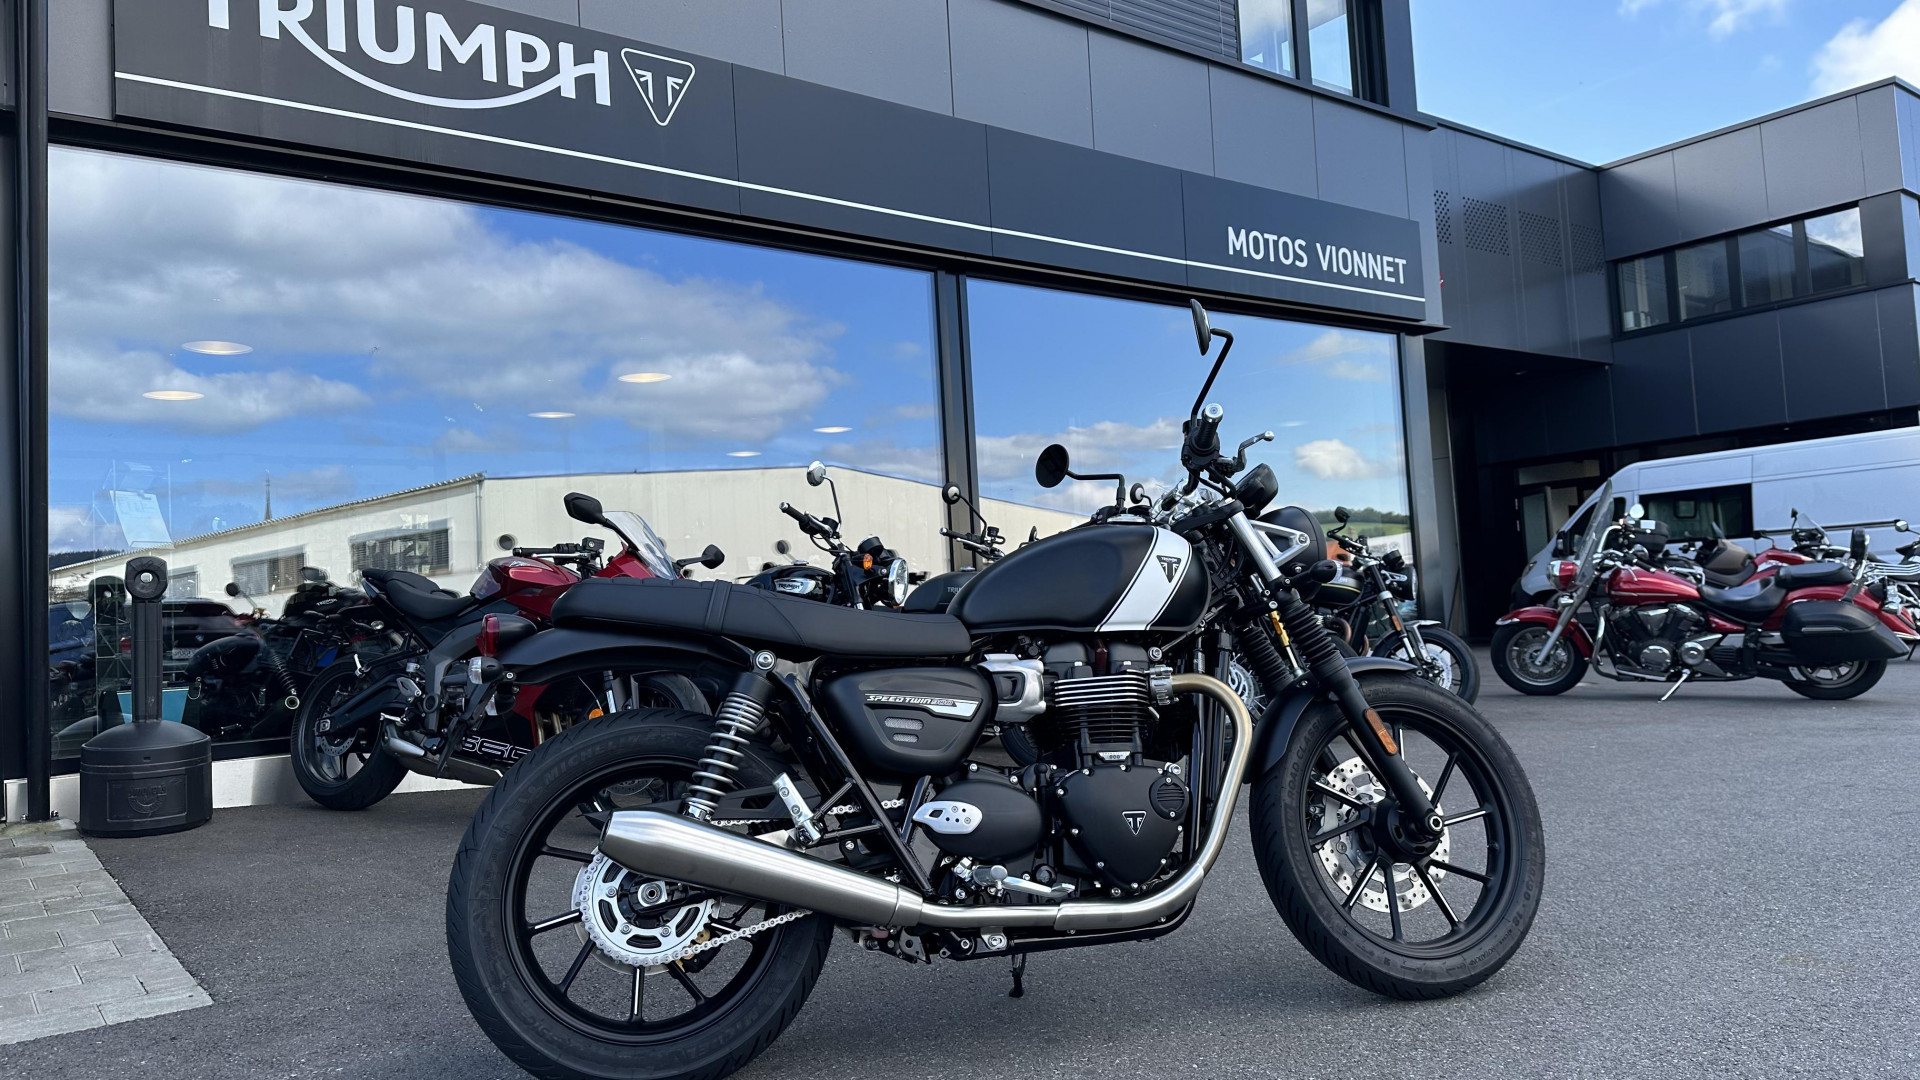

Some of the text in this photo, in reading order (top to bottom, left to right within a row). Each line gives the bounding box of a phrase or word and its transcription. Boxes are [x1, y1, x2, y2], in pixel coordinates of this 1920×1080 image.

[1227, 226, 1407, 285] MOTOS VIONNET
[867, 695, 903, 703] SPEED
[1287, 762, 1302, 799] ROAD
